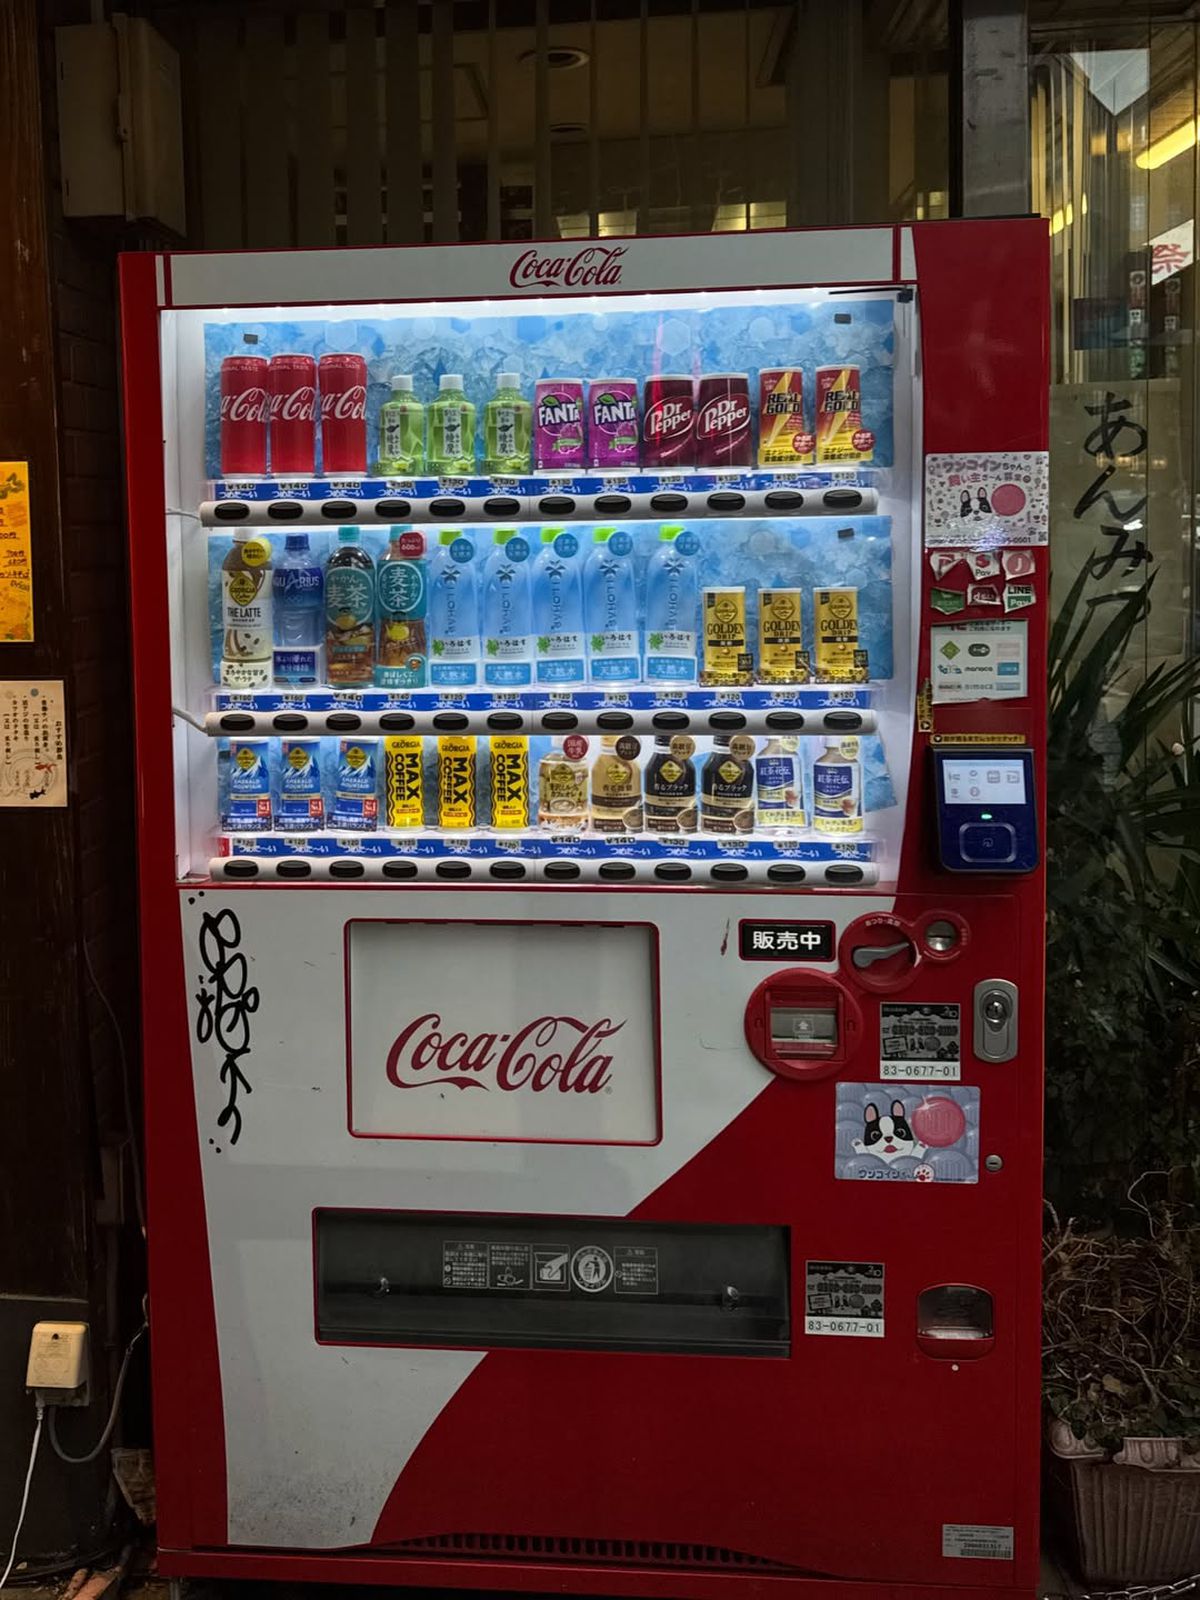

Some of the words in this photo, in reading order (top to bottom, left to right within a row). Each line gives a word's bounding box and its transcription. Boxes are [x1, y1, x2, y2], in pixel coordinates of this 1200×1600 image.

[509, 247, 630, 288] Coca-Cola
[538, 402, 580, 426] FANTA
[594, 401, 635, 425] FANTA
[664, 402, 682, 418] Dr
[717, 399, 737, 412] Dr
[650, 410, 691, 435] Pepper
[704, 407, 747, 433] Pepper
[327, 584, 369, 608] 麦茶
[388, 566, 409, 608] 麦茶
[1008, 586, 1031, 594] LINE
[240, 607, 261, 617] LATTE
[405, 753, 420, 800] MAX
[453, 757, 468, 804] MAX
[507, 754, 522, 802] MAX
[753, 931, 821, 951] 販売中
[386, 1013, 628, 1094] Coca-Cola
[883, 1065, 956, 1077] 83-0677-01
[808, 1321, 881, 1333] 83-0677-01
